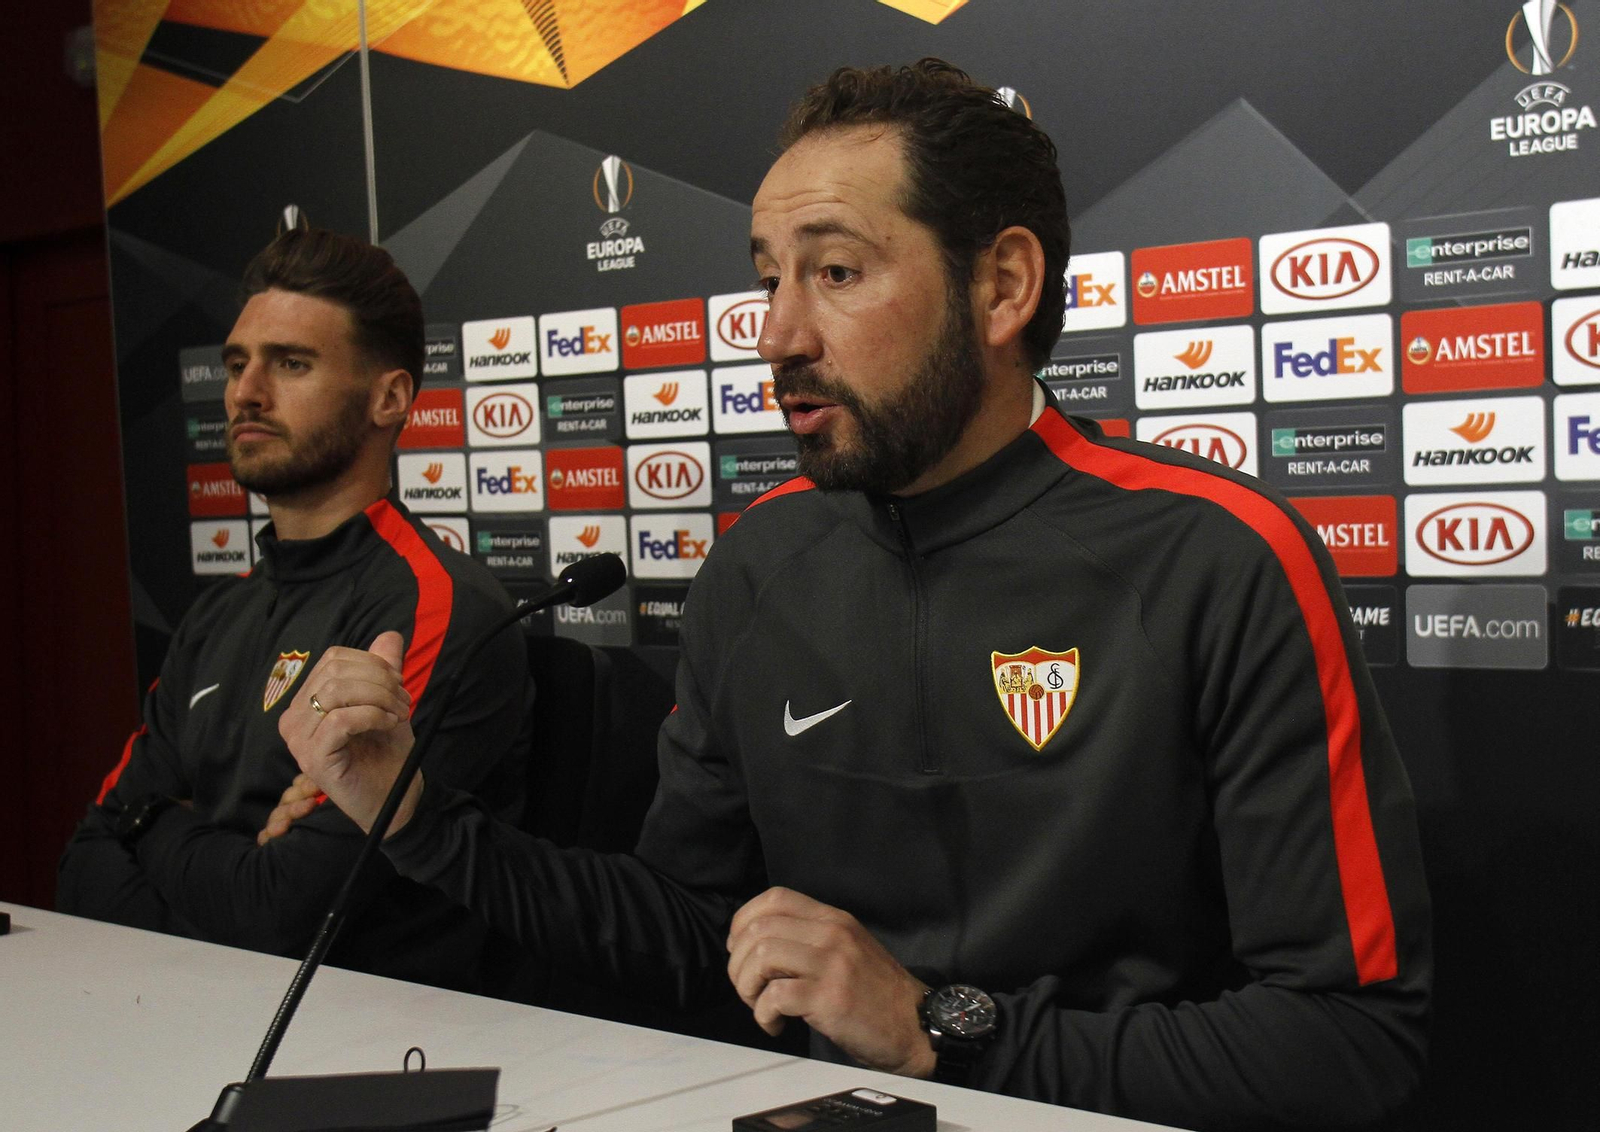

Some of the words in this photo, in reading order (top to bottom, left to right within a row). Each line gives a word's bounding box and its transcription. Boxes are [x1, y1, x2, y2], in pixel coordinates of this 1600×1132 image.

[1517, 86, 1566, 107] UEFA
[1490, 106, 1597, 140] EUROPA
[1509, 134, 1578, 157] LEAGUE
[587, 236, 645, 259] EUROPA
[1415, 233, 1529, 260] enterprise
[597, 256, 635, 271] LEAGUE
[1288, 251, 1361, 288] KIA
[1161, 265, 1246, 295] AMSTEL
[1424, 265, 1514, 286] RENT-A-CAR
[1065, 273, 1117, 310] dEx
[547, 325, 612, 358] FedEx
[642, 321, 700, 344] AMSTEL
[1274, 336, 1383, 379] FedEx
[1435, 331, 1535, 361] AMSTEL
[1043, 359, 1118, 378] nterprise
[720, 381, 778, 415] FedE
[1052, 386, 1107, 401] NT-A-CAR
[483, 402, 523, 429] KIA
[552, 397, 614, 414] enterprise
[412, 408, 460, 427] AMSTEL
[557, 418, 607, 433] RENT-A-CAR
[1280, 431, 1384, 452] enterprise
[646, 462, 693, 490] KIA
[726, 457, 797, 474] enterprise
[1288, 459, 1370, 476] RENT-A-CAR
[476, 464, 537, 496] FedEx
[565, 467, 620, 488] AMSTEL
[731, 481, 779, 495] RENT-A-C
[482, 534, 541, 548] enterprise
[639, 529, 709, 561] FedEx
[1316, 523, 1389, 547] MSTEL
[1435, 517, 1514, 552] KIA
[486, 555, 534, 567] RENT-A-CAR
[557, 604, 627, 625] UEFA.com
[1414, 614, 1539, 639] UEFA.com
